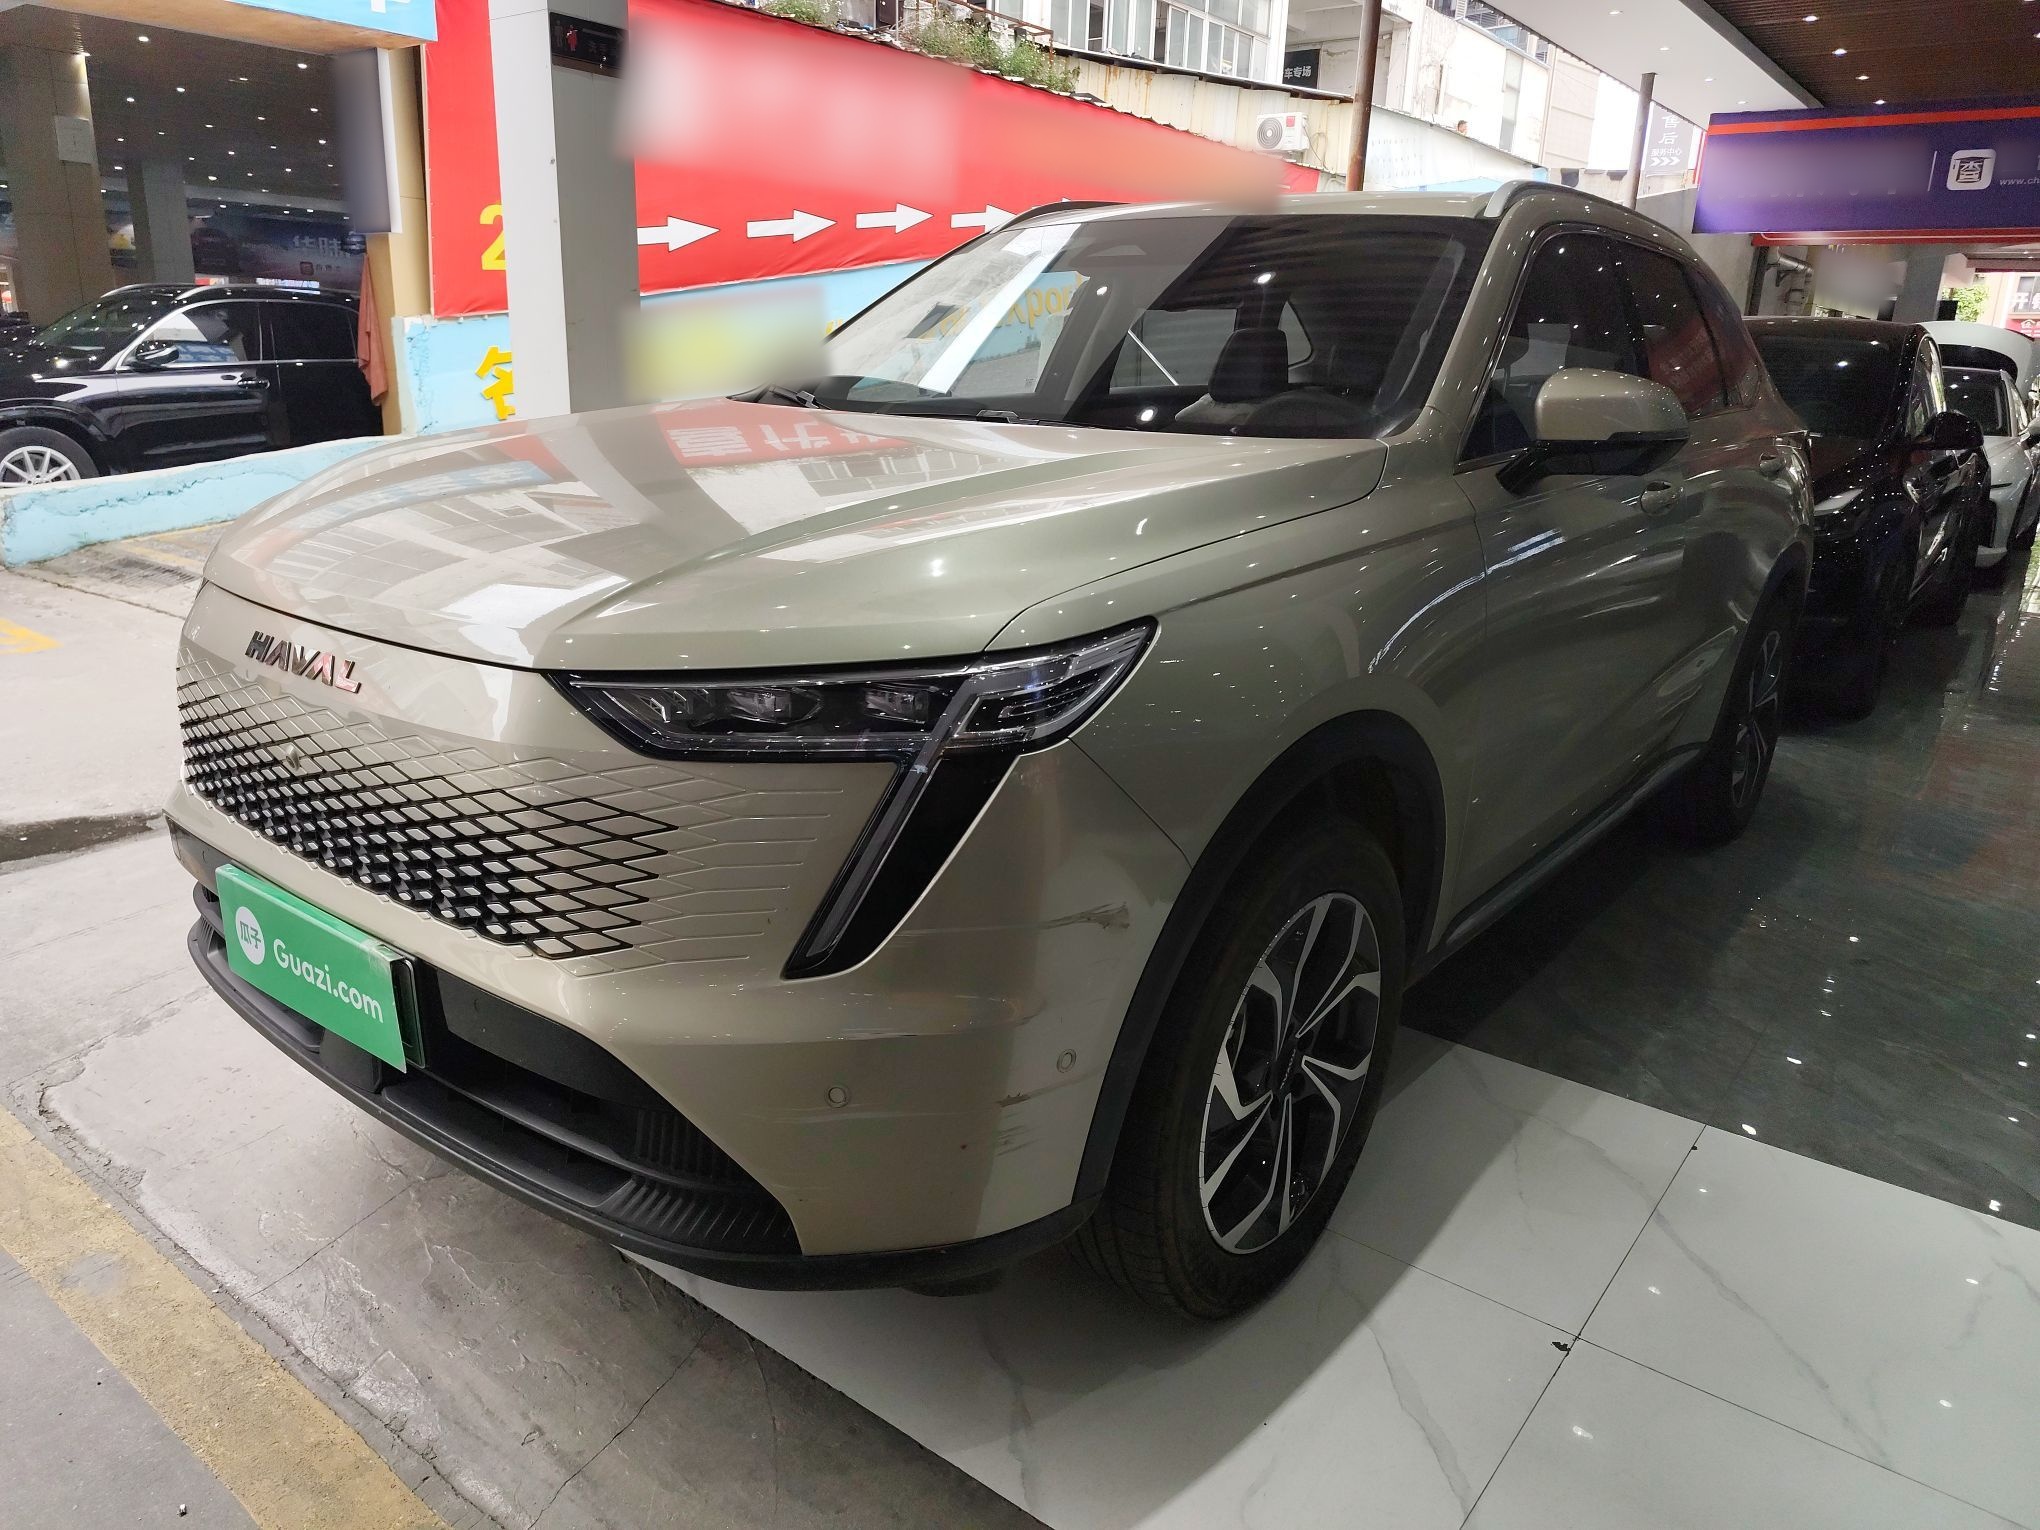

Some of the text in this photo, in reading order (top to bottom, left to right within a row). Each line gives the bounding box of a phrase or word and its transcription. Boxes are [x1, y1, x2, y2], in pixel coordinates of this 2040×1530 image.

[1284, 65, 1312, 79] 车专场
[245, 630, 361, 694] HAVAL
[240, 920, 262, 950] 瓜子
[273, 938, 384, 1023] Guazi.com
